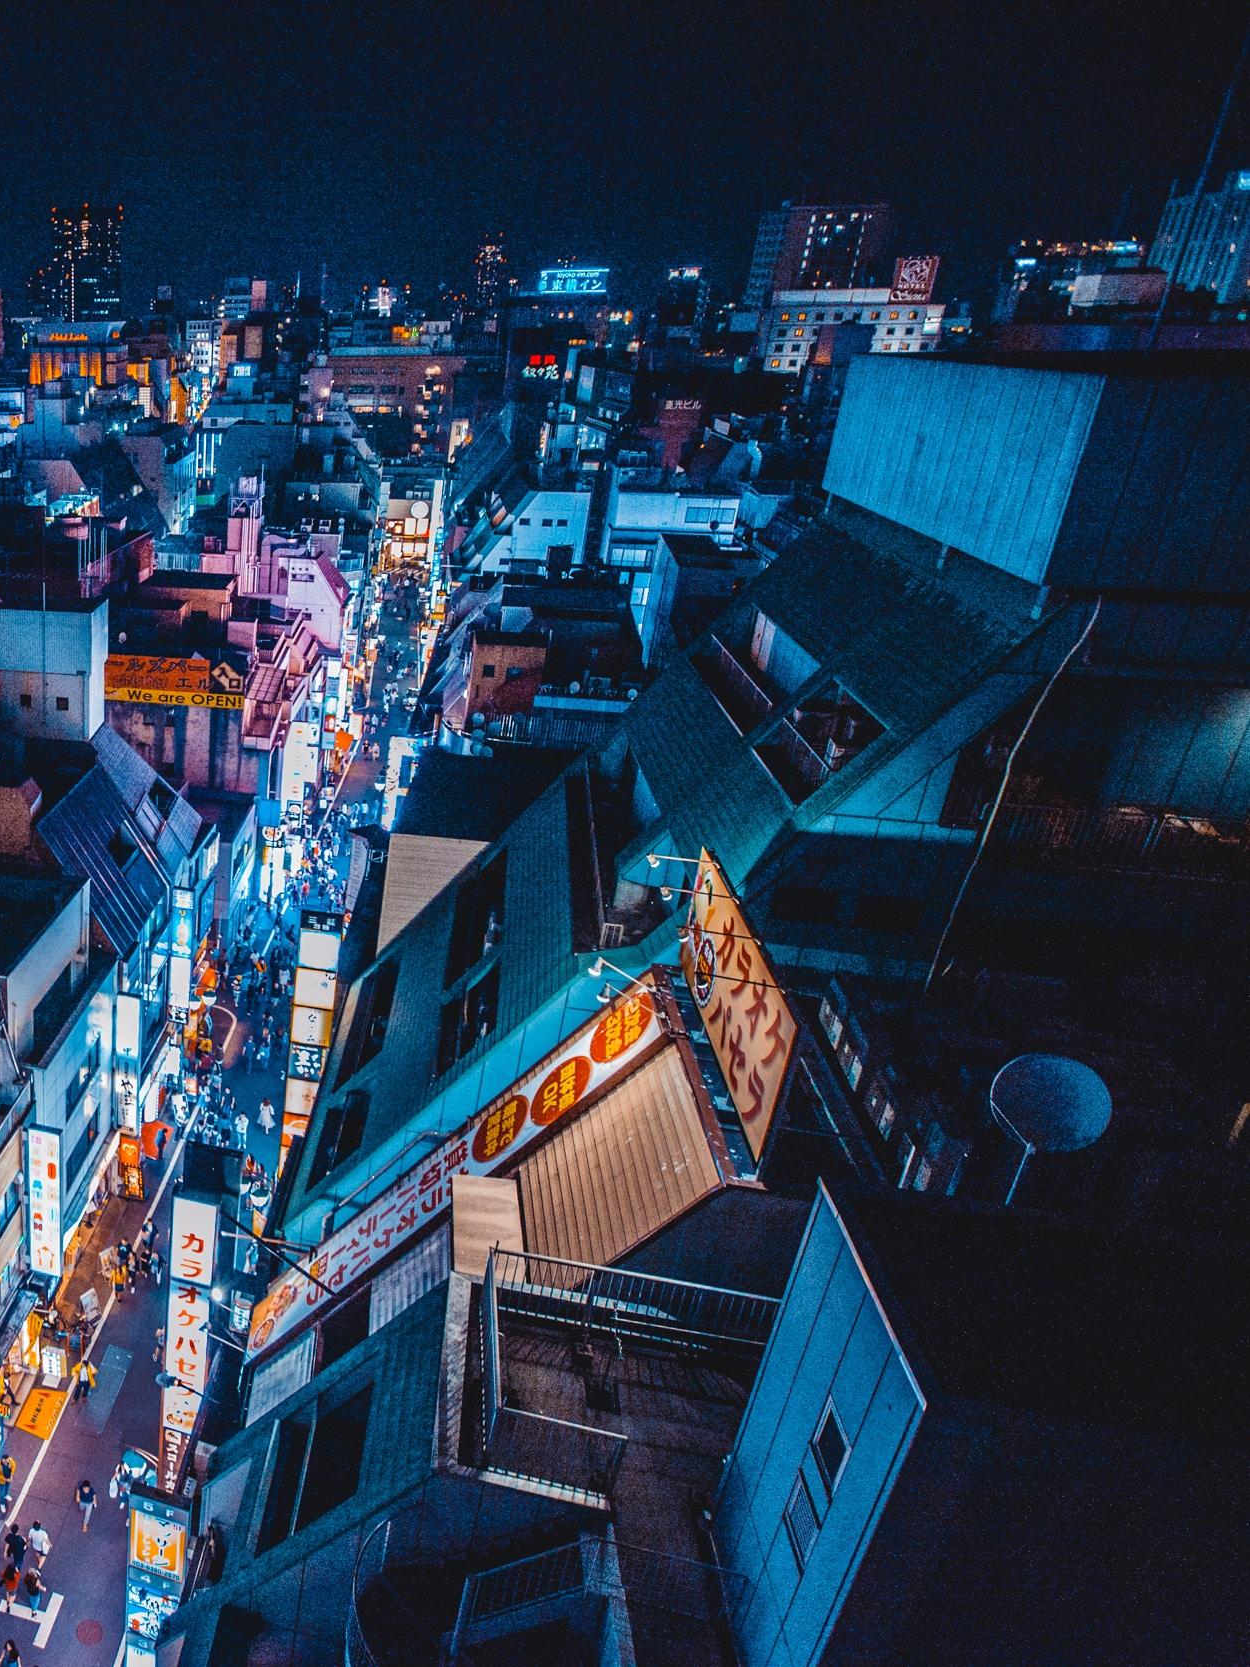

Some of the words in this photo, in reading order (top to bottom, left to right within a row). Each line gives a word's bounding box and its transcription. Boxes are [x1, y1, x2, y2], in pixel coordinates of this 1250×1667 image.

[104, 656, 208, 674] ールズバー
[217, 666, 241, 689] 入口
[127, 689, 153, 701] We
[158, 693, 184, 704] are
[191, 693, 242, 708] OPEN!
[716, 916, 786, 1066] カラオケ
[709, 997, 764, 1122] パセラ
[543, 1082, 559, 1113] OK
